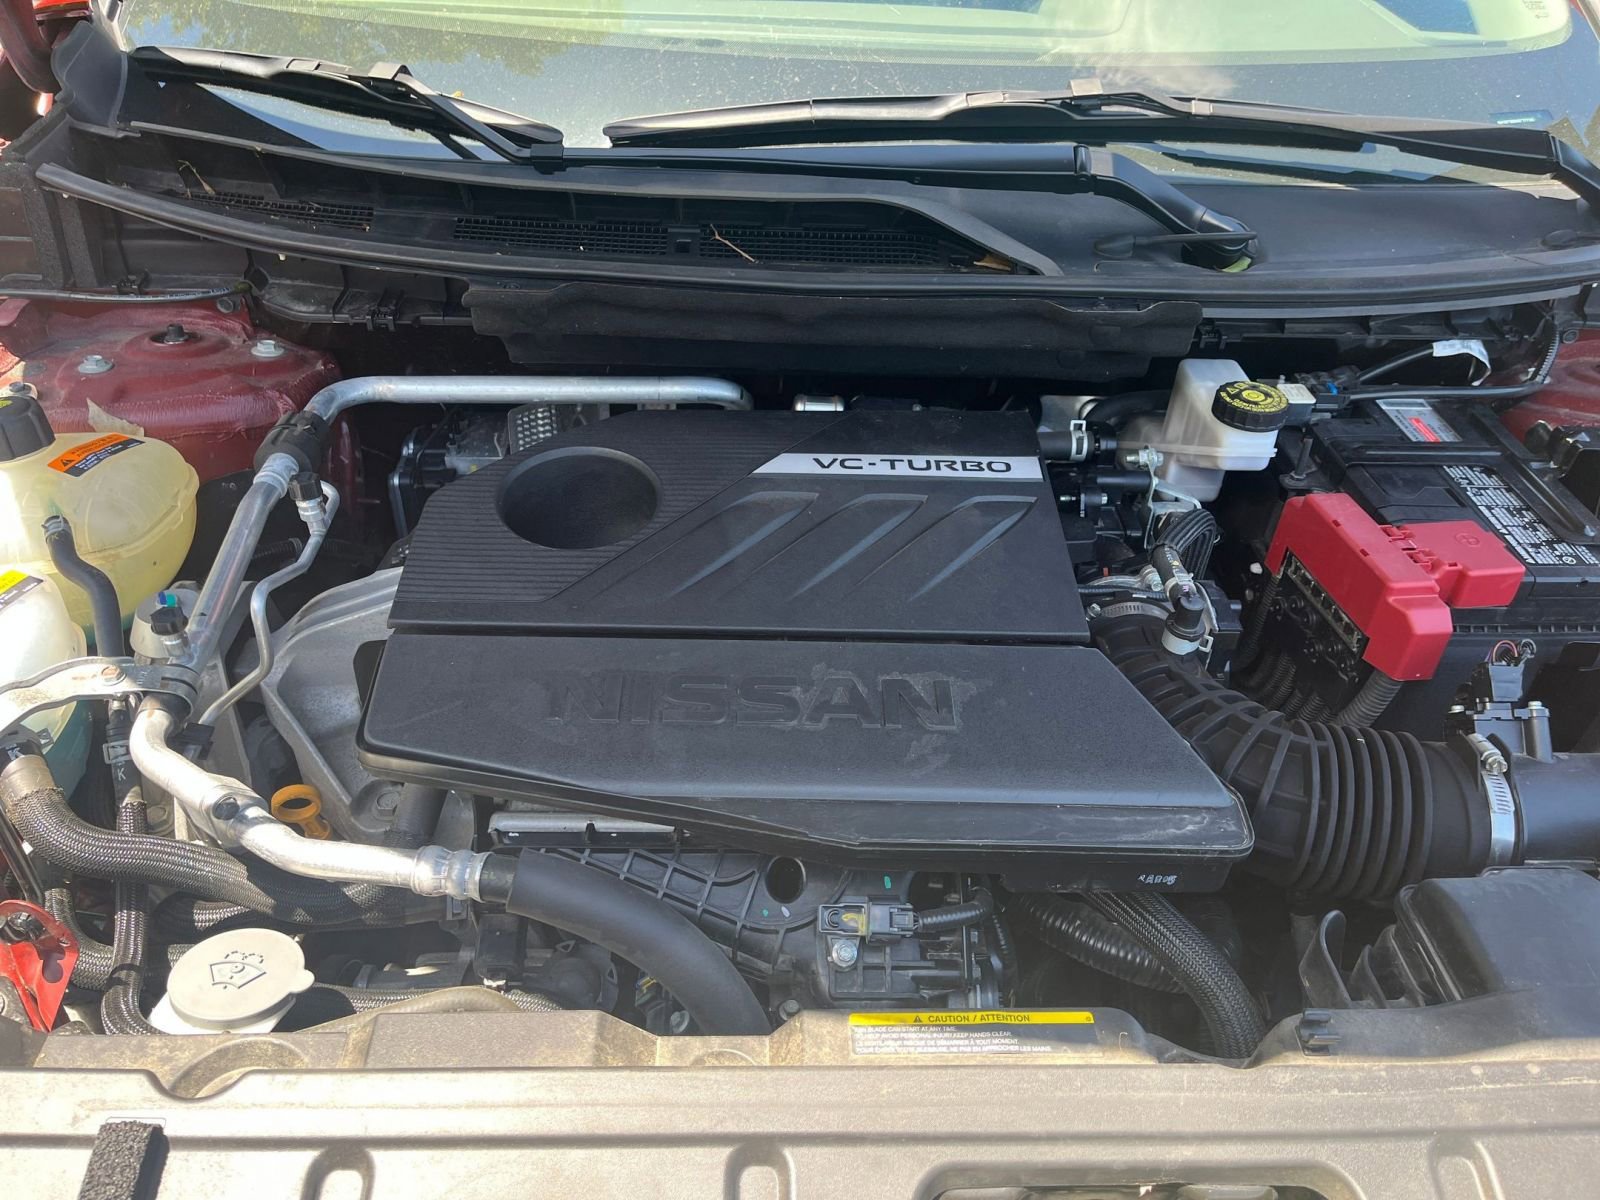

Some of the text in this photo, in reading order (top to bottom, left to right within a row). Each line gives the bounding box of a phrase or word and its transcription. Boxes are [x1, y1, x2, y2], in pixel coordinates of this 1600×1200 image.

[545, 669, 958, 731] NISSAN
[927, 1013, 1030, 1023] CAUTION / ATTENTION
